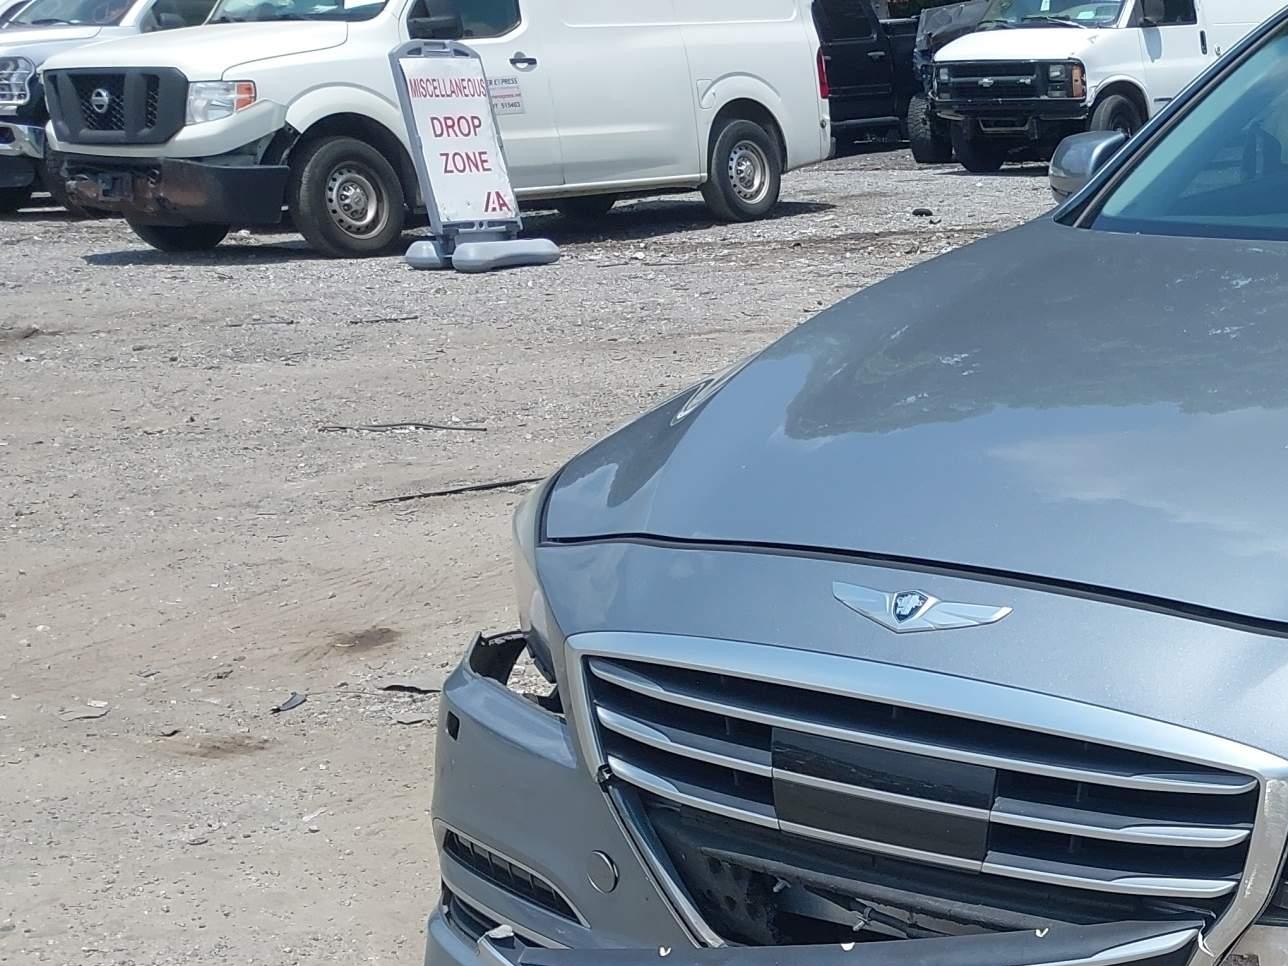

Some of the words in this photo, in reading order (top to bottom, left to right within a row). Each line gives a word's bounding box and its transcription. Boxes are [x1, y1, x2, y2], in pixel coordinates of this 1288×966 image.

[409, 78, 487, 98] MISCELLANEOUS
[430, 115, 482, 137] DROP
[440, 151, 492, 173] ZONE
